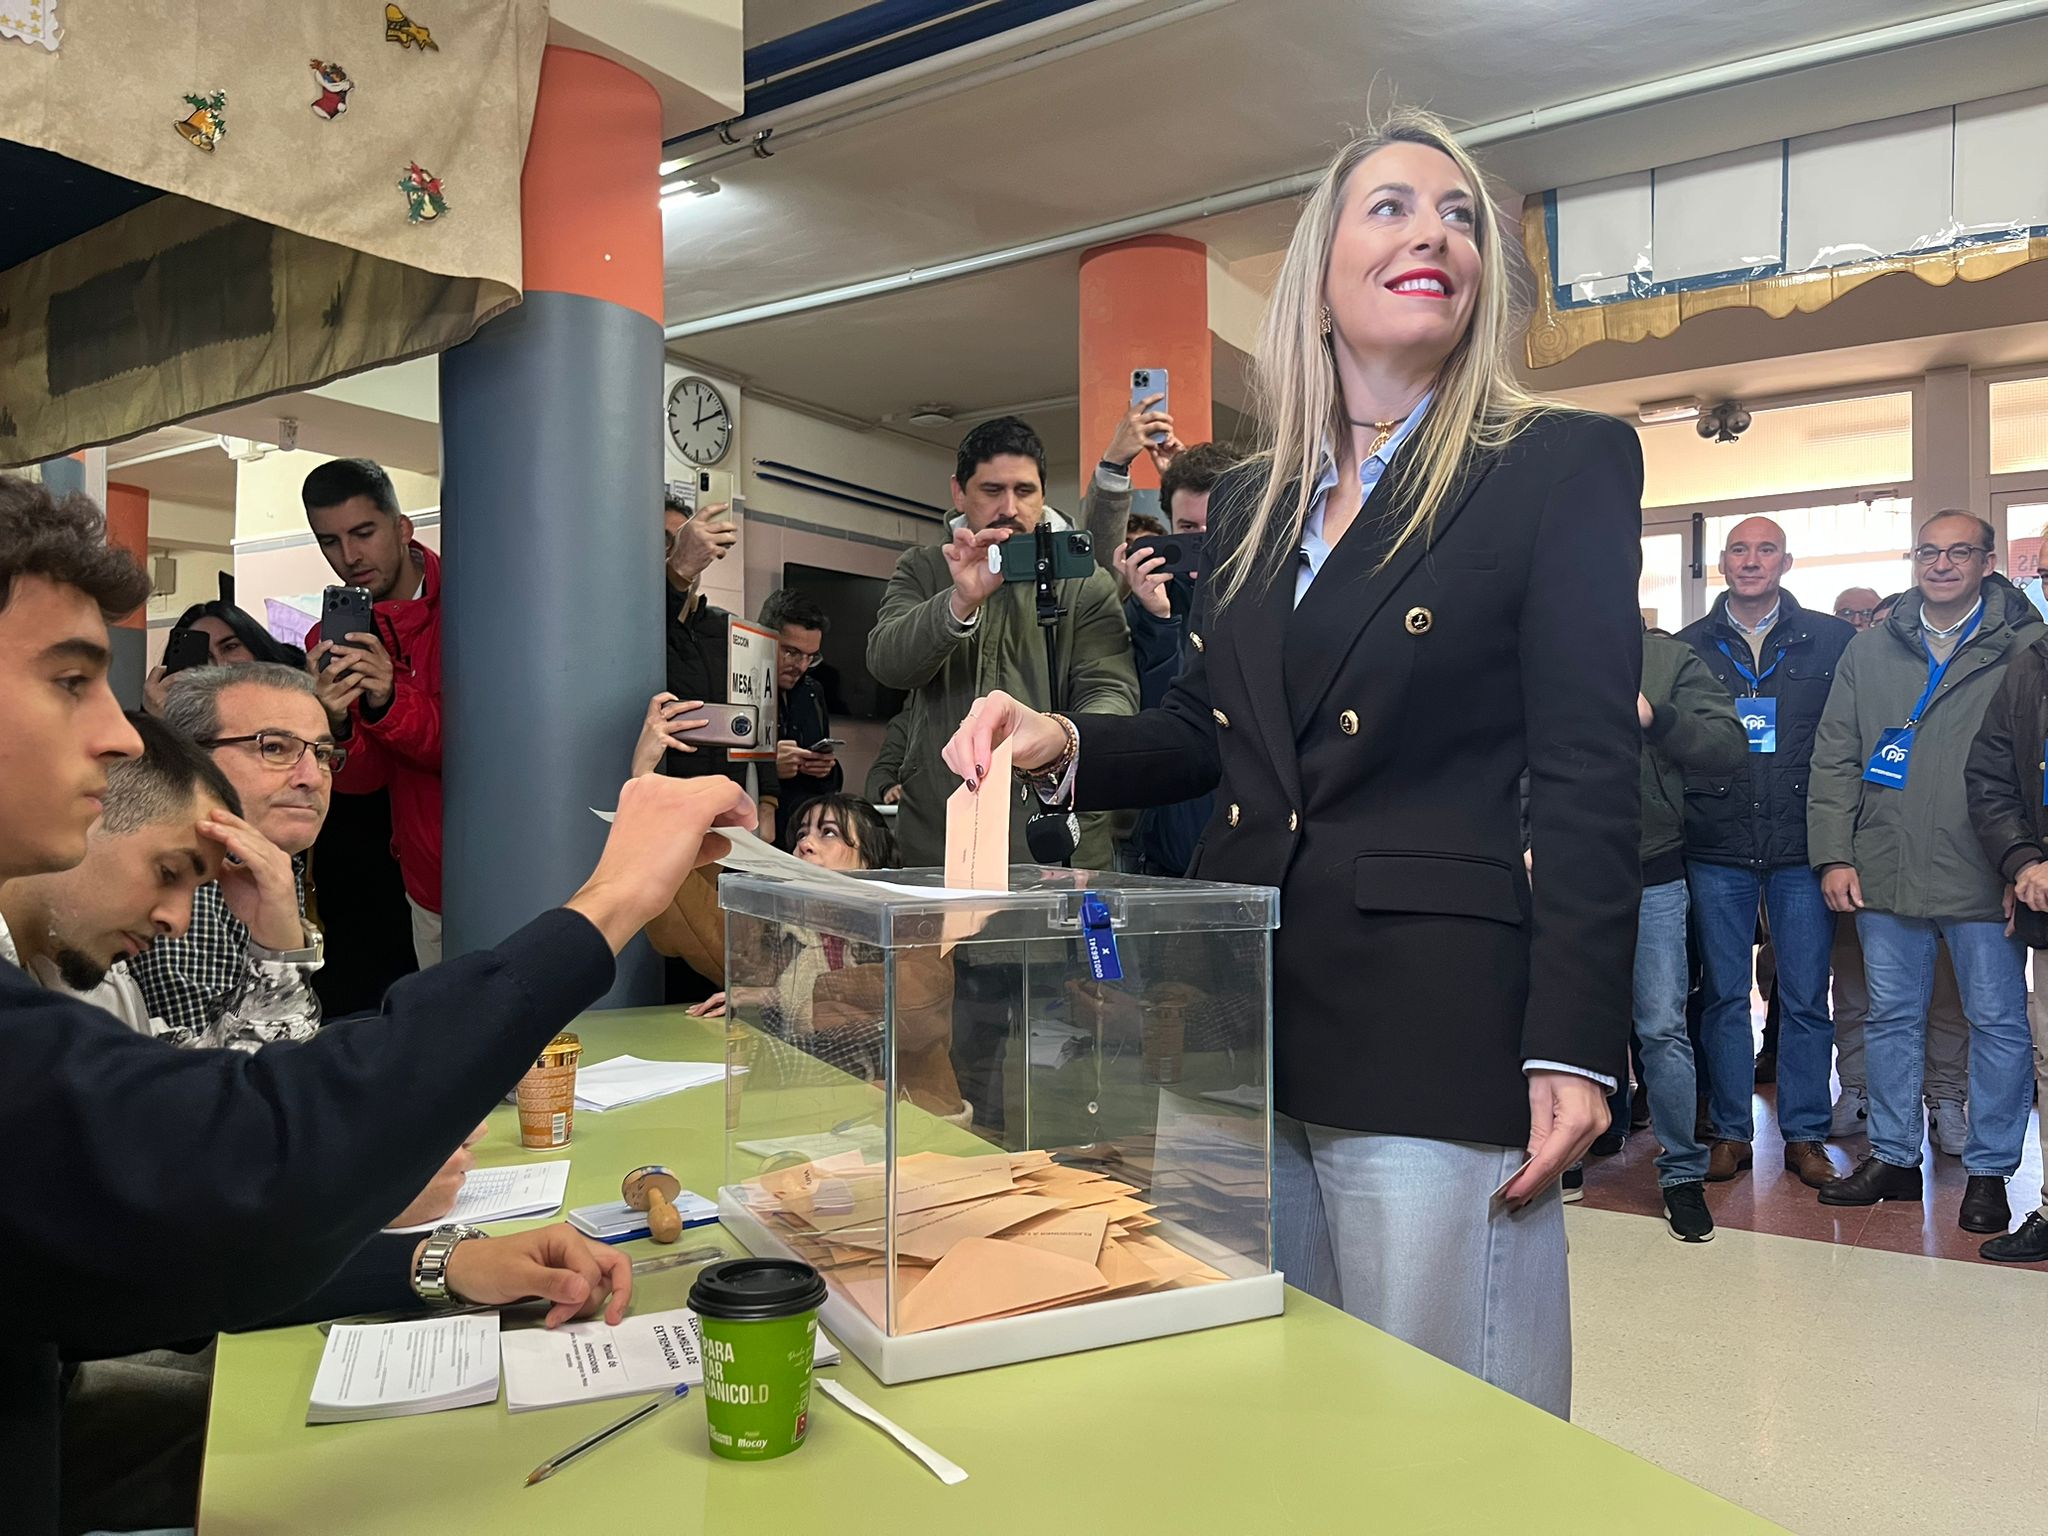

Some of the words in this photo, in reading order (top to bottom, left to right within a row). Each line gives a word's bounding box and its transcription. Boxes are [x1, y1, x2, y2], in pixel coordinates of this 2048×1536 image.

[732, 672, 753, 696] MESA
[763, 667, 772, 699] A
[764, 725, 772, 746] K
[653, 1325, 681, 1371] EXTREMADURA
[672, 1325, 694, 1358] ASAMBLEA
[686, 1355, 700, 1366] DE
[702, 1335, 735, 1363] PARA
[701, 1353, 724, 1381] TAR
[737, 1438, 768, 1449] Mocay
